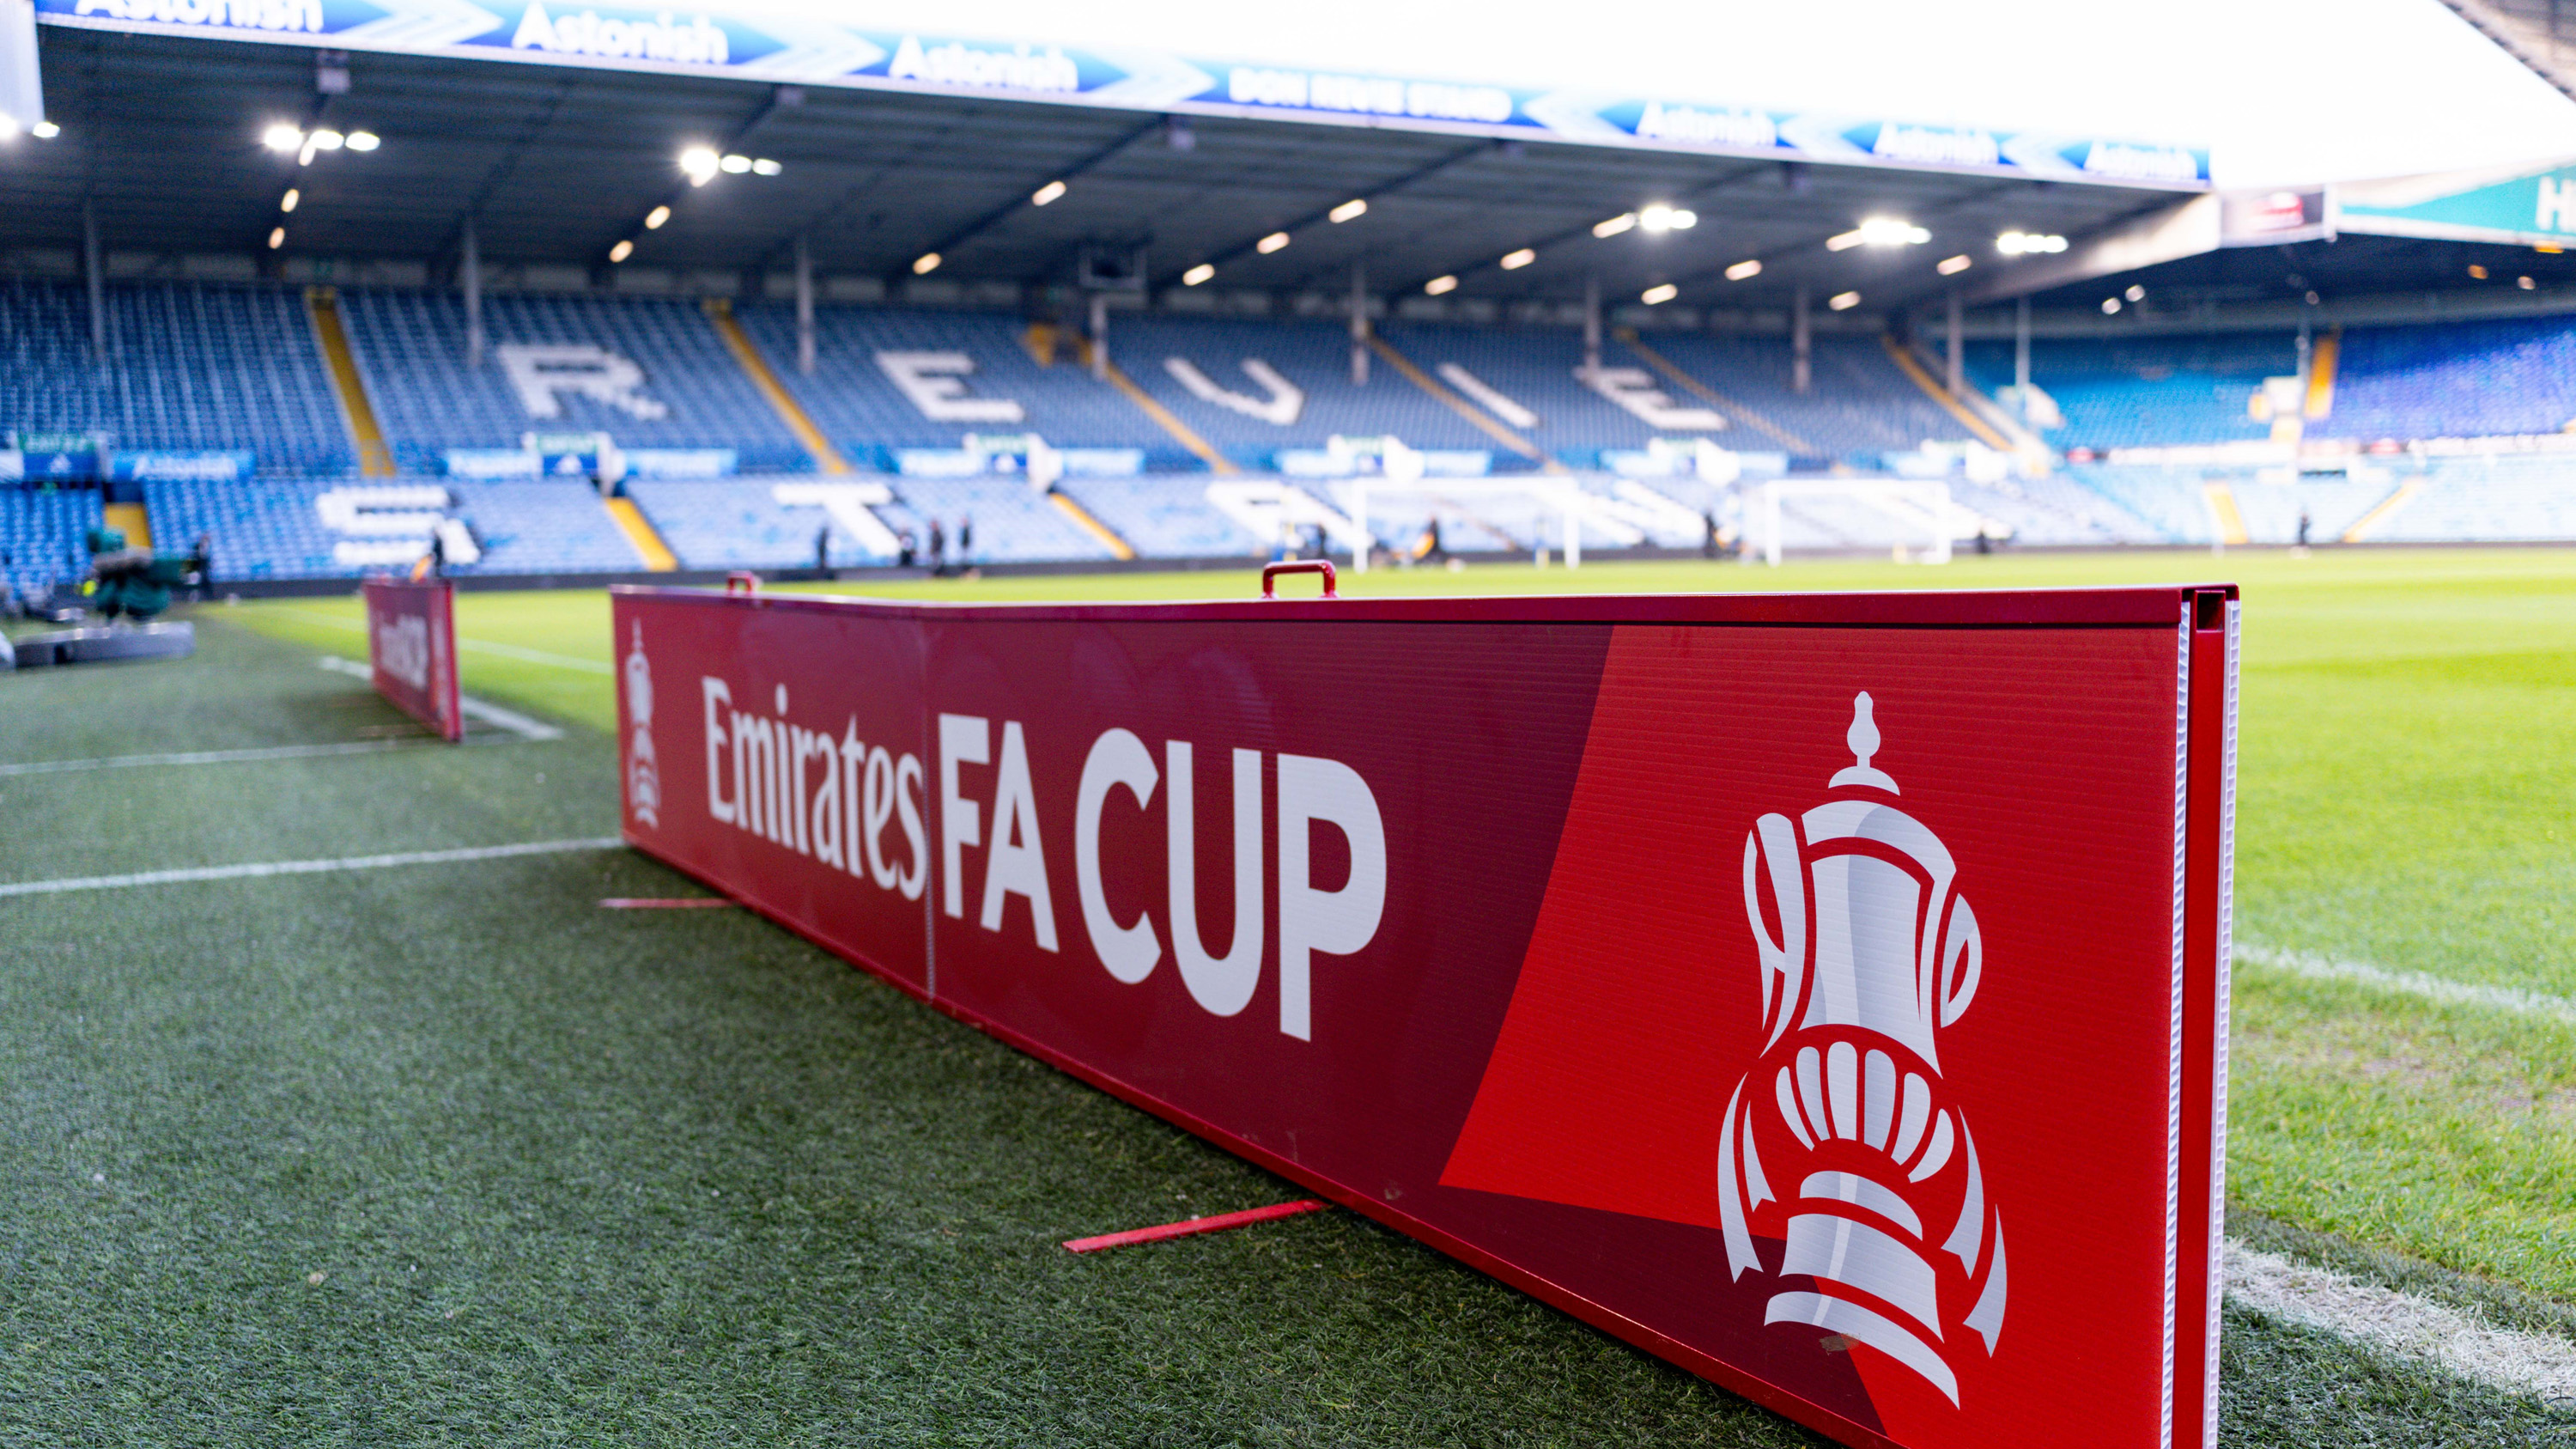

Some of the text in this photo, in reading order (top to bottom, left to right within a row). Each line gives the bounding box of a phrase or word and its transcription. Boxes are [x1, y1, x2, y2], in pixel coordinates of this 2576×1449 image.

[74, 0, 325, 33] onish
[511, 0, 729, 65] Astonish
[888, 34, 1078, 91] Astonish
[2535, 176, 2576, 232] H
[702, 676, 1388, 1044] Emirates FA CUP
